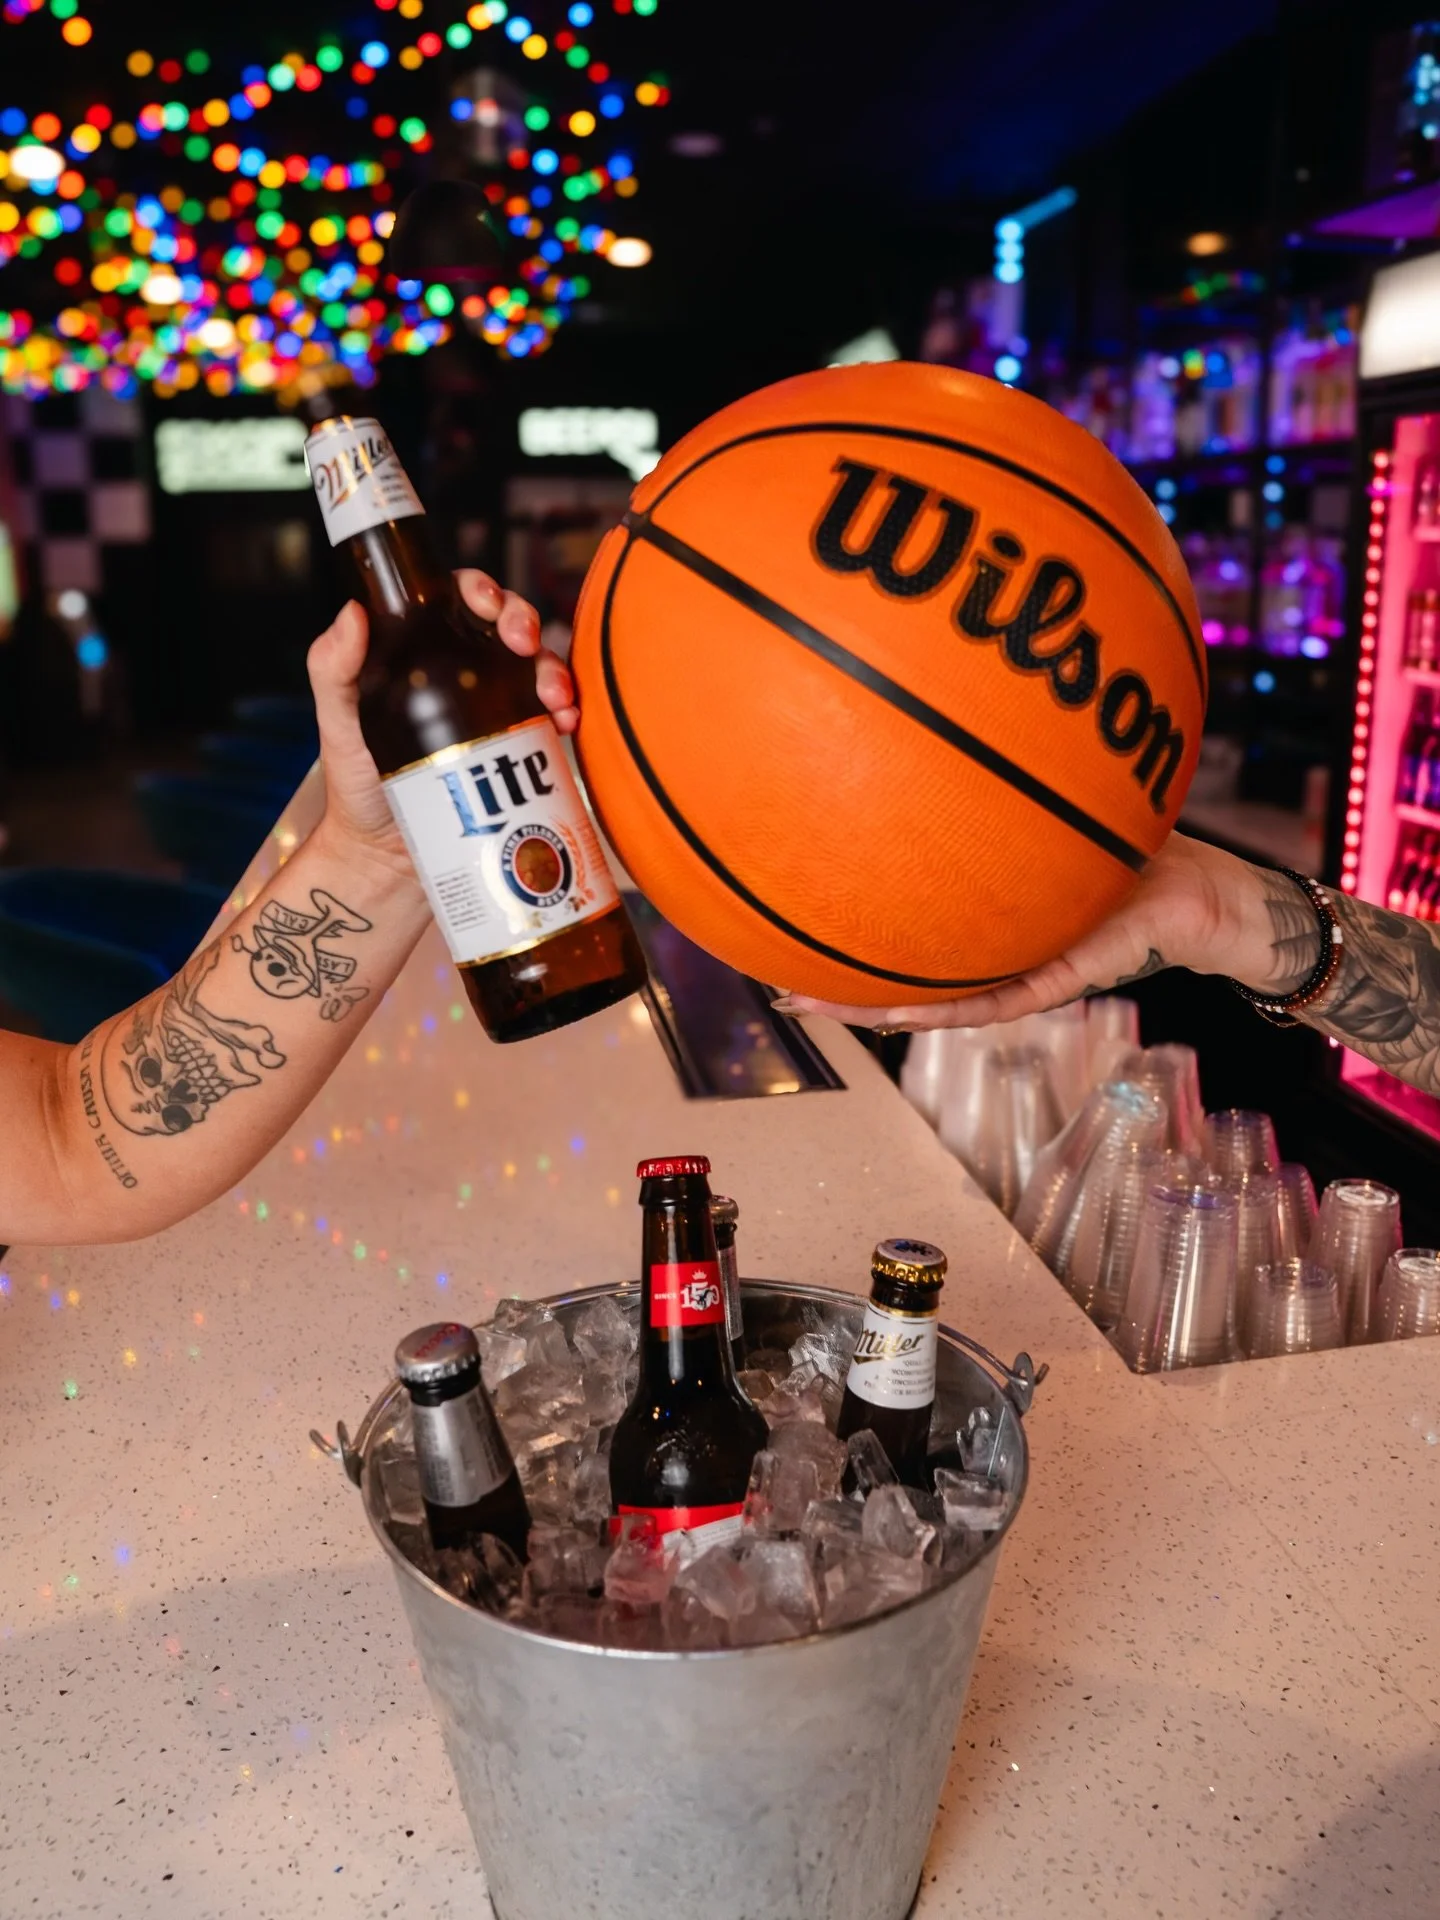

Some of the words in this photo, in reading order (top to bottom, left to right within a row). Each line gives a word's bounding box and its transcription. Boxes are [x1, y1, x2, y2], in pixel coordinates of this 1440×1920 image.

[811, 457, 1185, 816] Wilson
[436, 750, 555, 837] Lite
[503, 832, 521, 860] FINE
[521, 826, 564, 851] PILSNER
[537, 888, 566, 907] BEER
[274, 908, 309, 930] CALL
[855, 1329, 925, 1354] Miller
